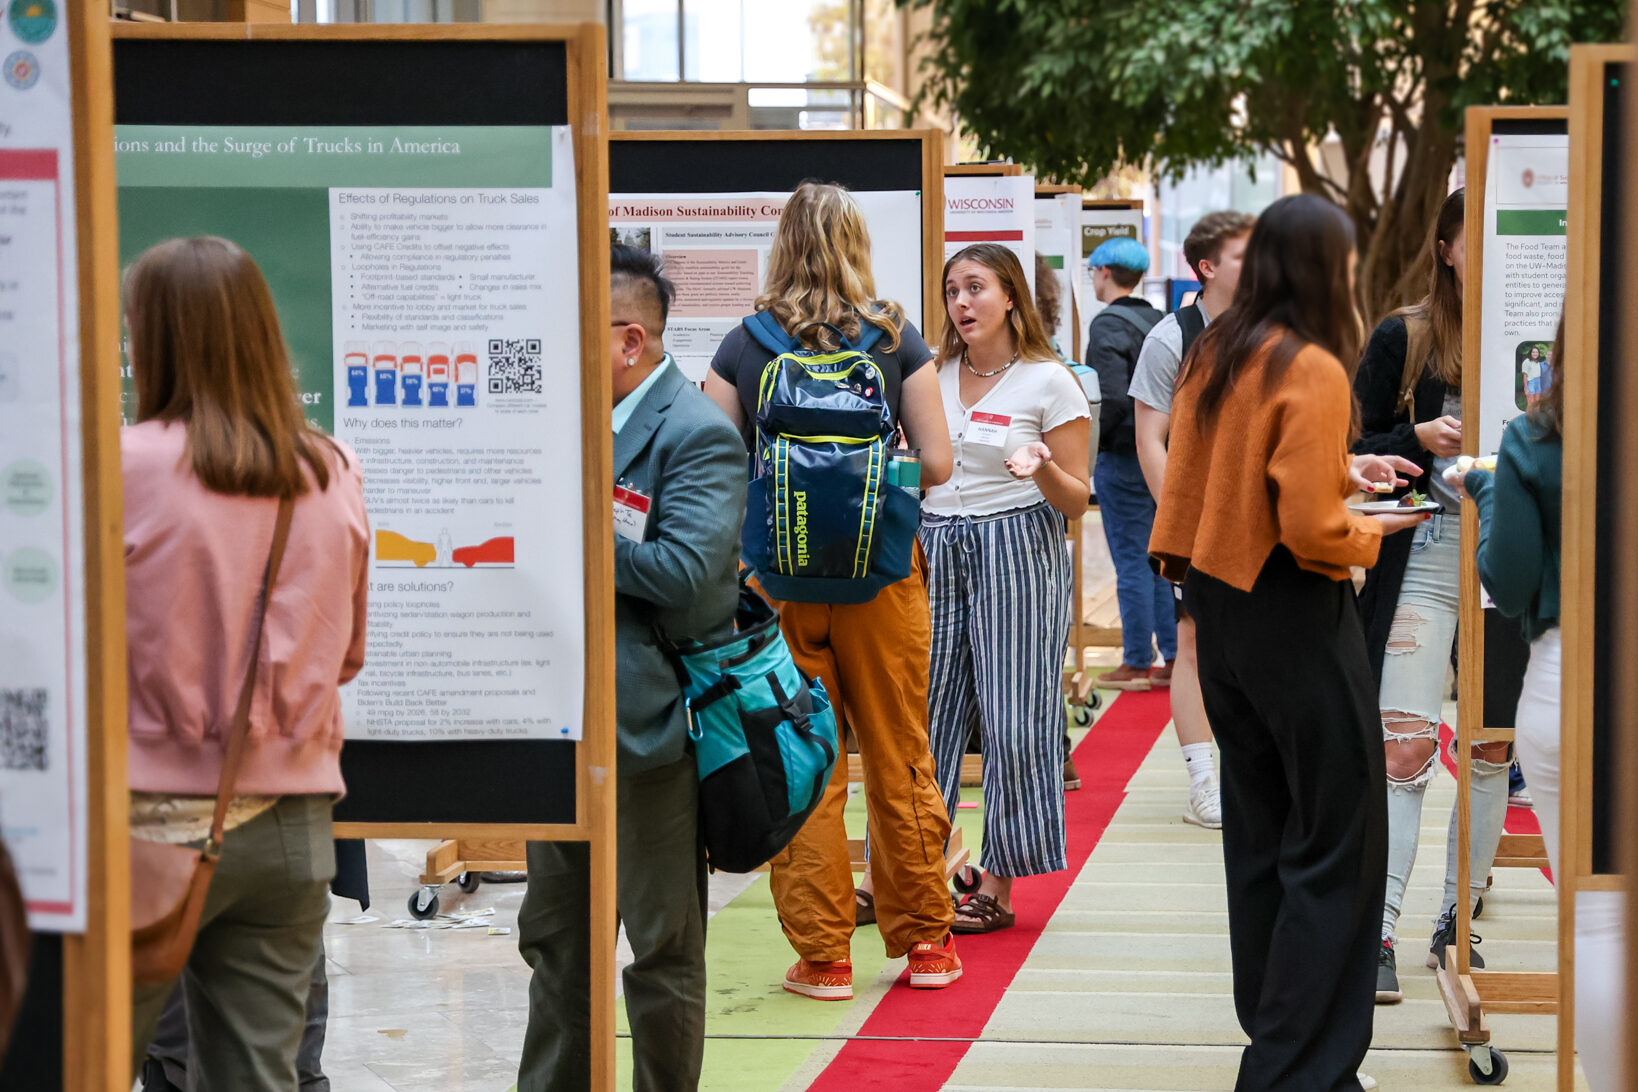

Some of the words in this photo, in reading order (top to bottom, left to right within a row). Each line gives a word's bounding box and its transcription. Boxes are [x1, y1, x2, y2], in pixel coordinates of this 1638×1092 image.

[155, 136, 185, 152] and
[192, 136, 219, 152] the
[224, 136, 273, 156] Surge
[277, 136, 298, 152] of
[303, 136, 362, 152] Trucks
[367, 136, 384, 152] in
[390, 136, 460, 152] America
[338, 193, 376, 203] Effects
[379, 193, 390, 203] of
[393, 193, 457, 206] Regulations
[460, 195, 474, 204] on
[479, 193, 506, 204] Truck
[511, 193, 539, 204] Sales
[948, 198, 1014, 209] WISCONSIN
[608, 206, 619, 216] of
[623, 206, 673, 216] Madison
[677, 206, 756, 219] Sustainability
[1084, 227, 1106, 236] Crop
[1108, 227, 1129, 235] Yield
[1514, 291, 1542, 300] improve
[1504, 300, 1544, 309] significant,
[1504, 320, 1536, 328] practices
[344, 418, 367, 430] Why
[371, 418, 397, 428] does
[401, 418, 419, 428] this
[422, 418, 462, 428] matter?
[794, 491, 809, 567] patagonia
[398, 582, 454, 592] solutions?
